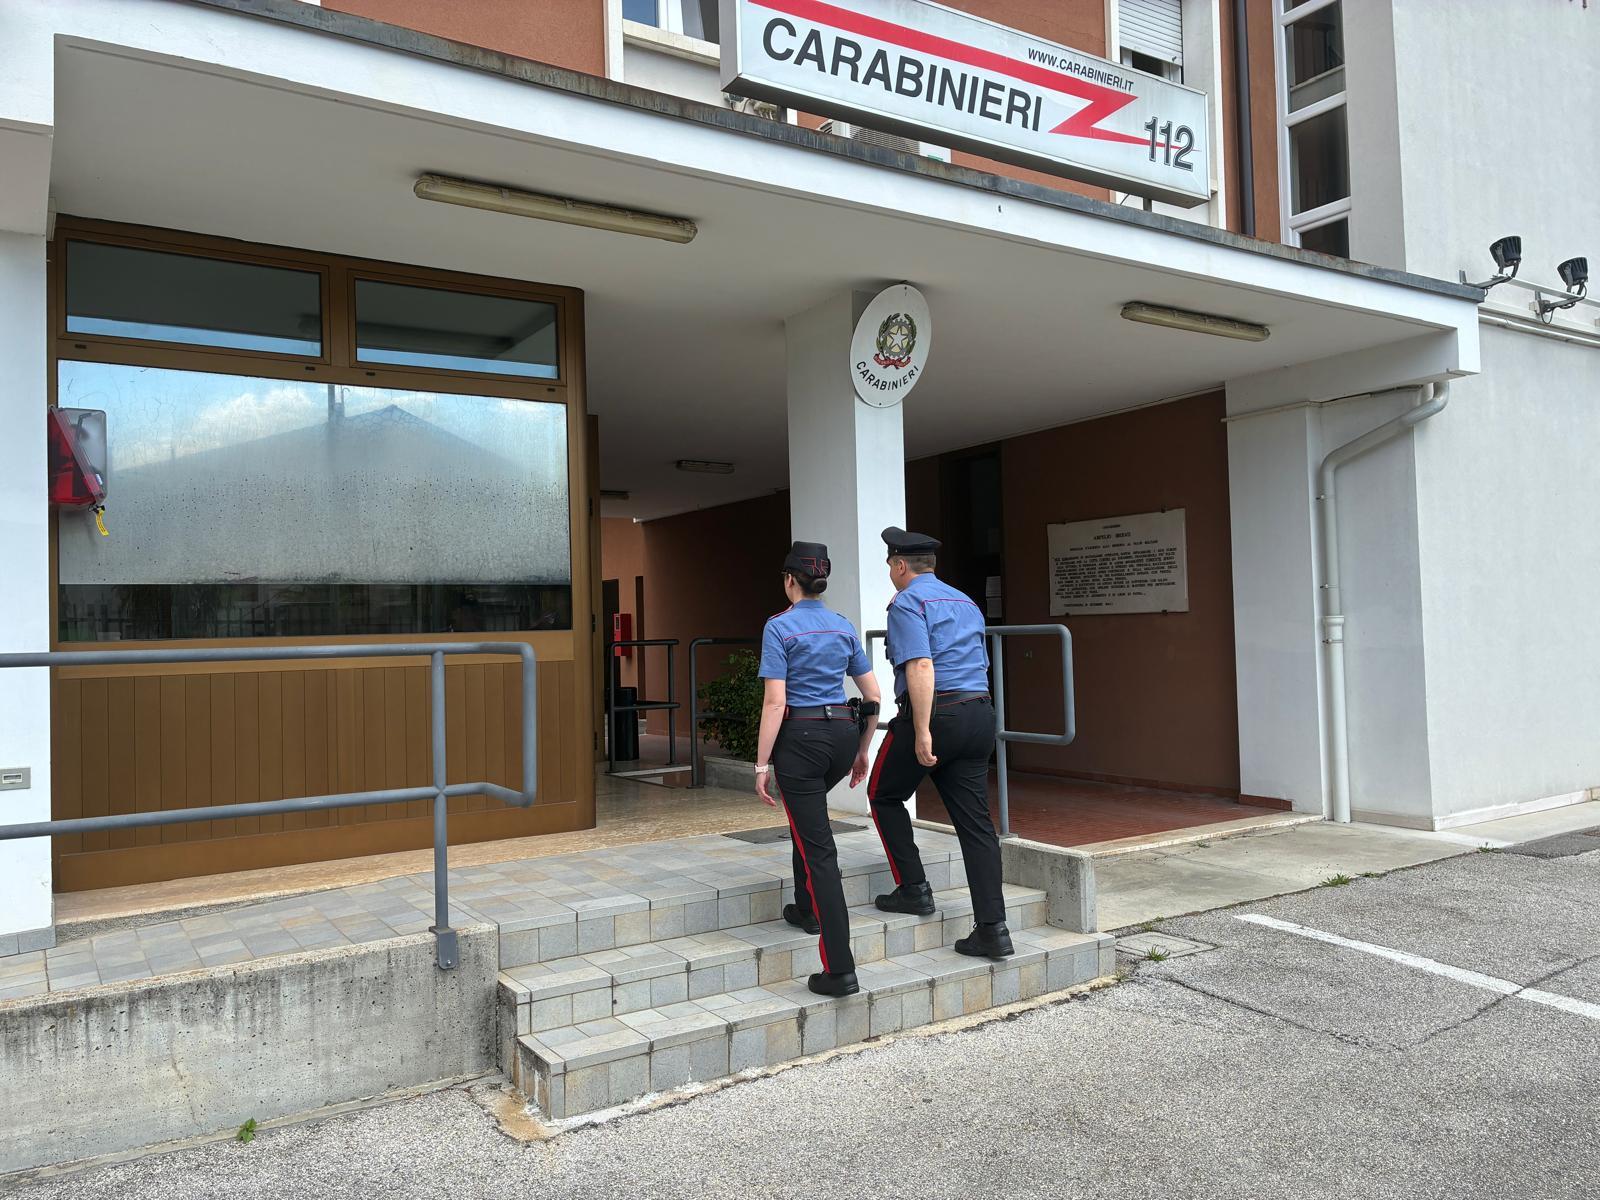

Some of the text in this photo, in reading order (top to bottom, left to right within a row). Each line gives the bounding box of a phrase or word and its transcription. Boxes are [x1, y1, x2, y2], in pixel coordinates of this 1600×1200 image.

[763, 17, 1042, 132] CARABINIERI
[1028, 48, 1134, 92] WWW.CARABINIERI.IT
[1144, 116, 1195, 172] 112
[856, 361, 919, 391] CARABINIERI
